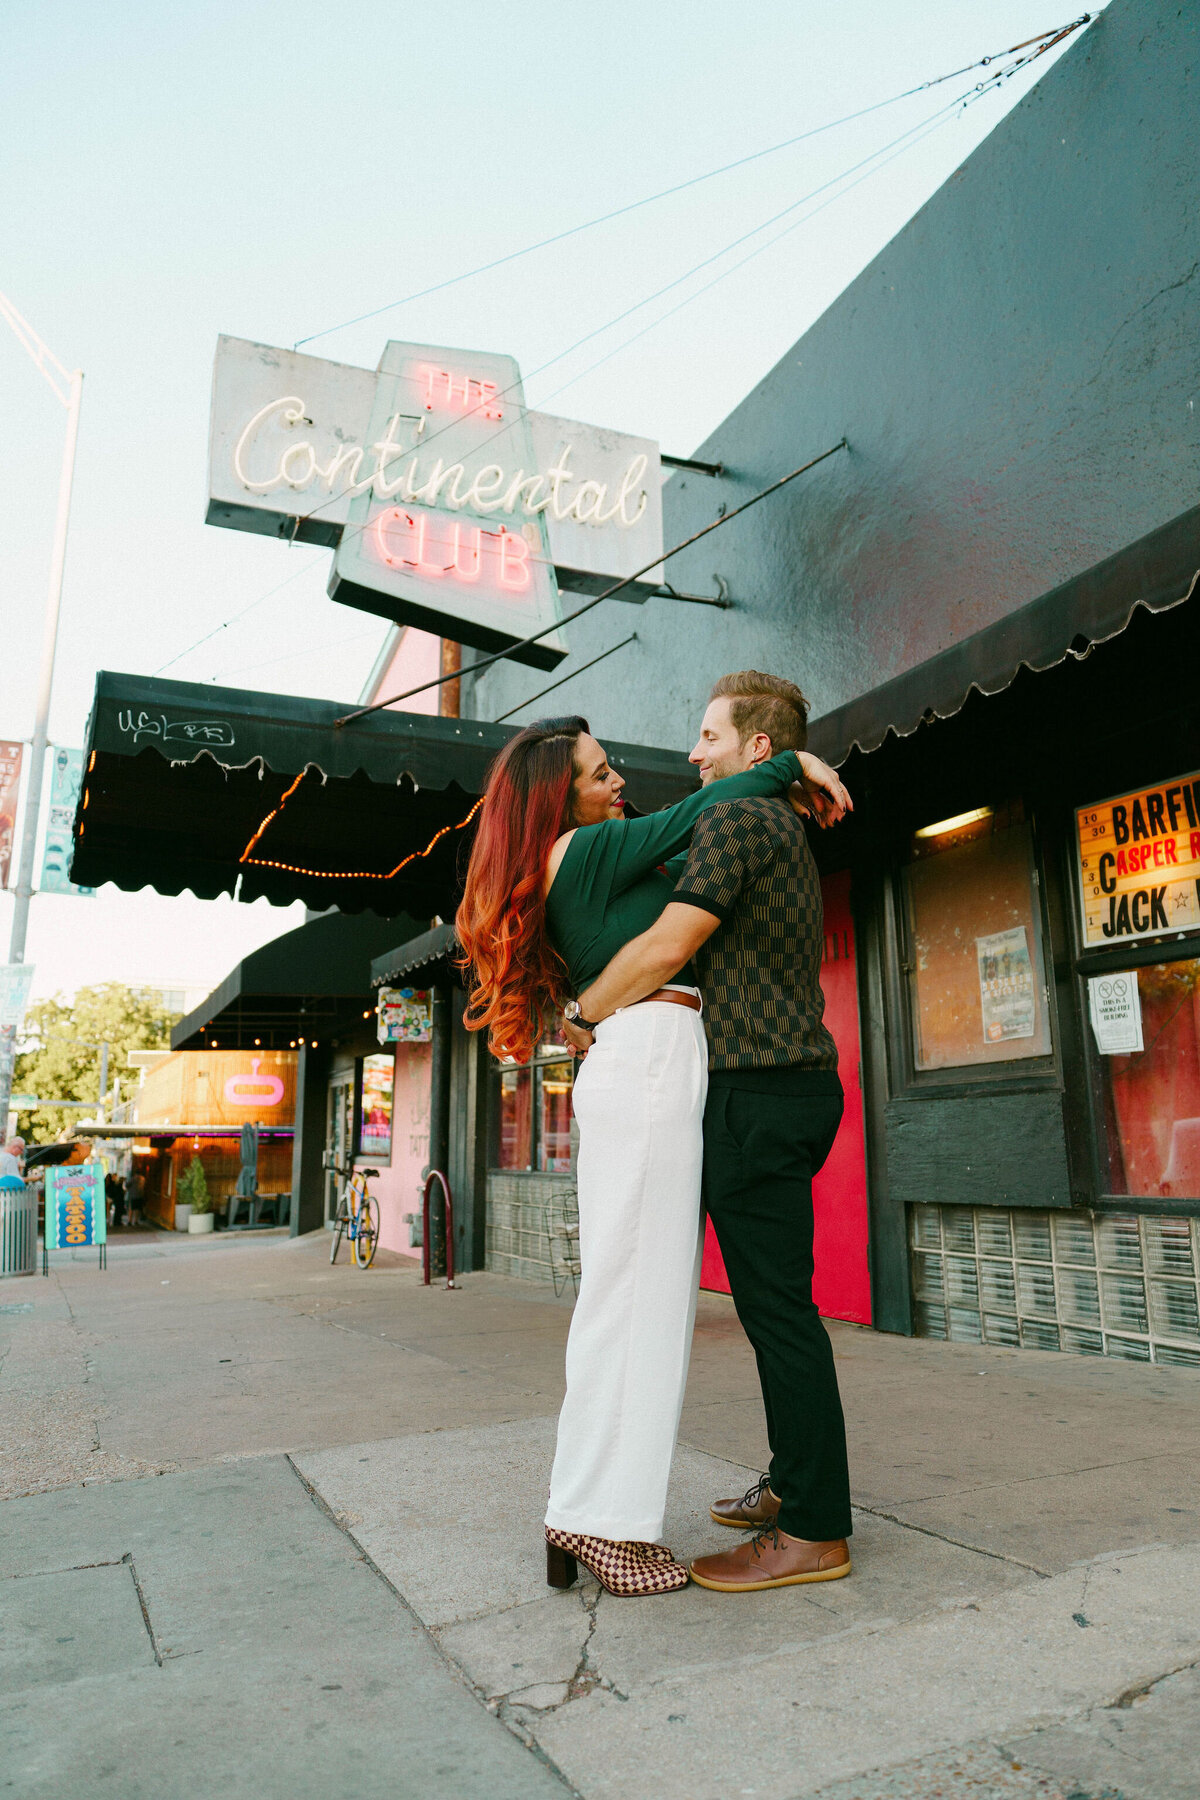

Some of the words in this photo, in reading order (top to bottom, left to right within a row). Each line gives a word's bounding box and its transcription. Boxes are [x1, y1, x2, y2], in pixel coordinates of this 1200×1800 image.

[418, 364, 503, 420] THE
[233, 396, 649, 527] Continental
[376, 506, 531, 590] CLUB
[1092, 825, 1106, 837] 30
[1100, 838, 1178, 894] CASPER
[1102, 886, 1169, 938] JACK
[1103, 1013, 1129, 1021] BUILDING
[65, 1186, 87, 1244] TATTOO
